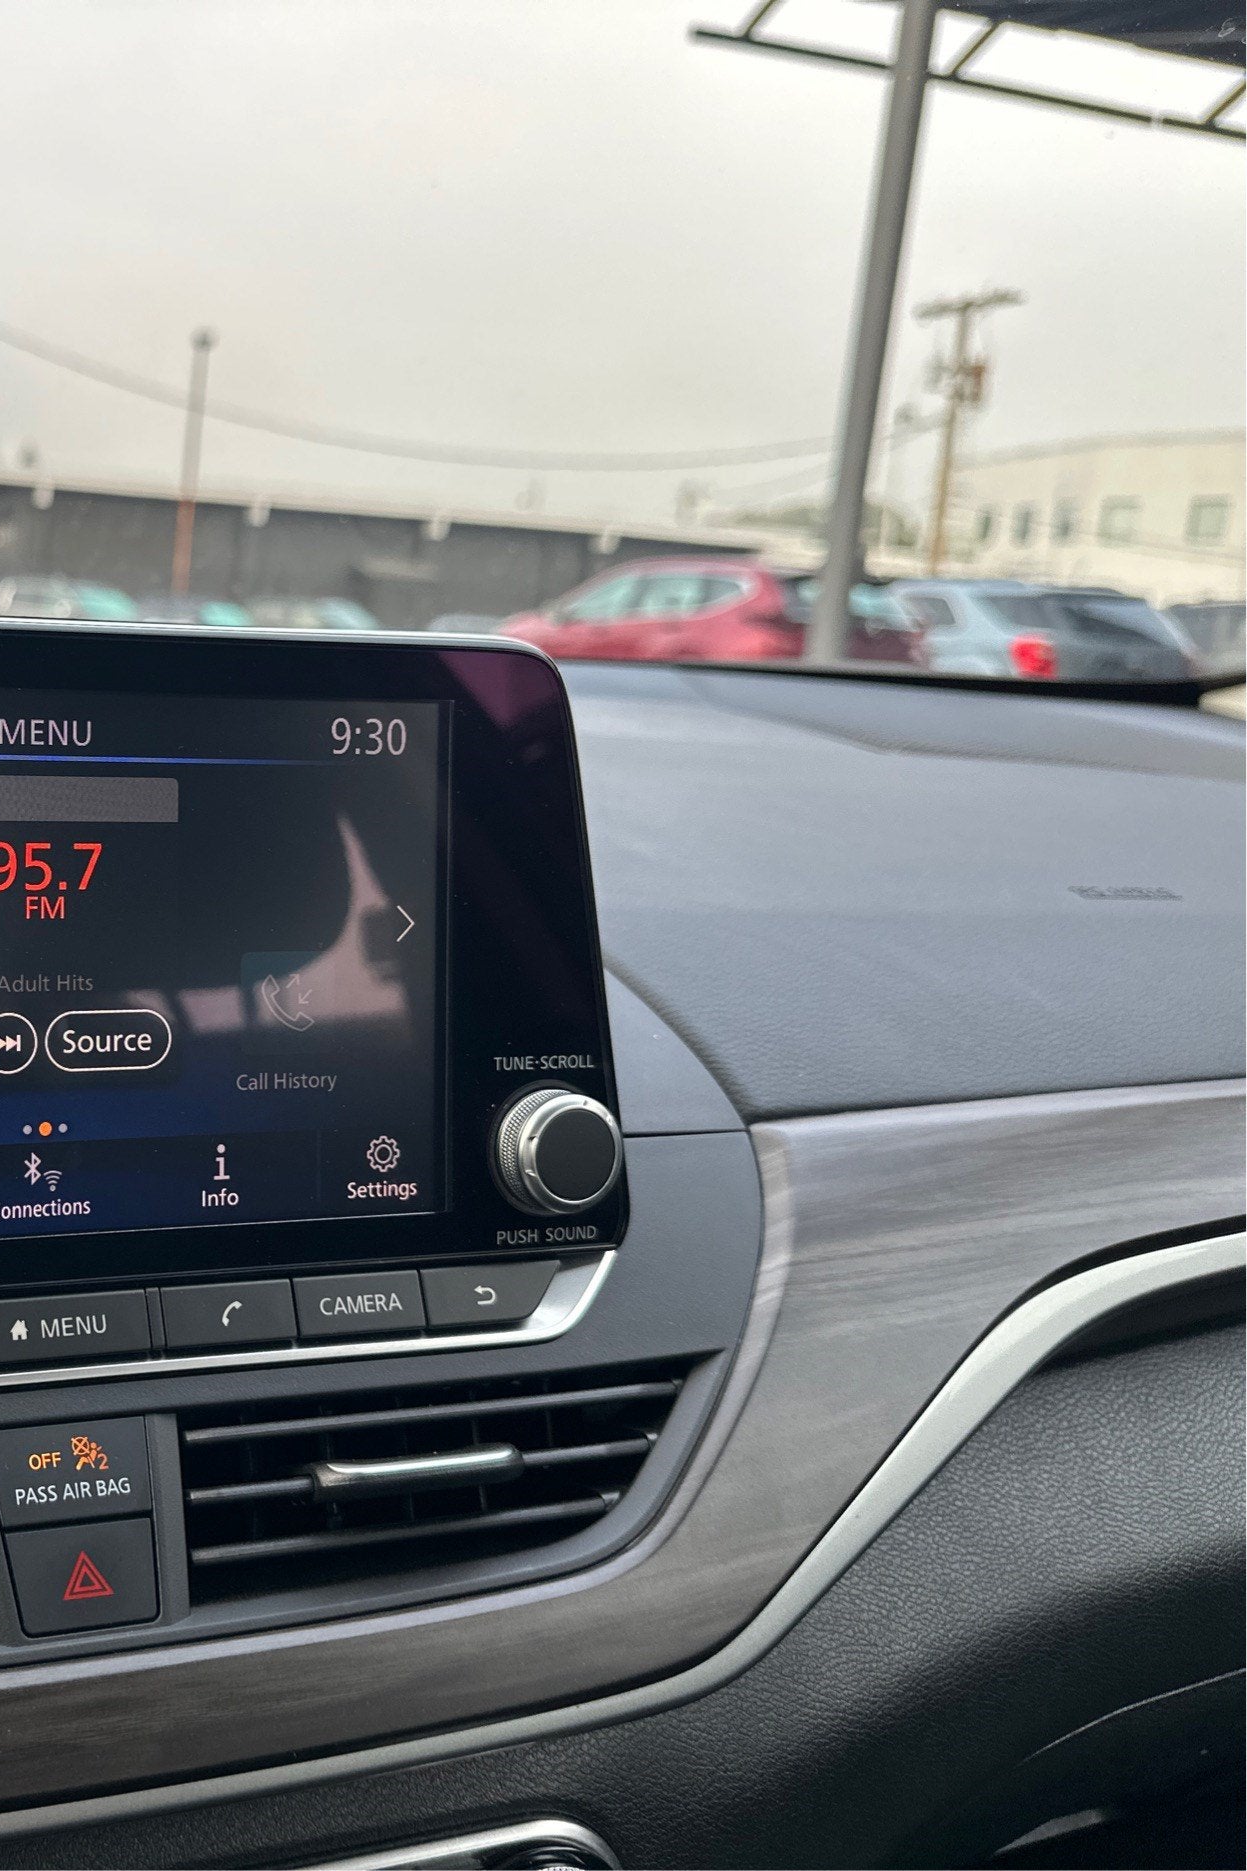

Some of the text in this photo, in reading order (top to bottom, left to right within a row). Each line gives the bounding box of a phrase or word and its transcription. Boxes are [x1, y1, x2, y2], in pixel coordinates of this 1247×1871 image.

[331, 717, 407, 756] 9:30
[25, 895, 65, 920] FM
[57, 974, 94, 992] Hits
[62, 1029, 152, 1054] Source
[236, 1072, 338, 1092] Call History
[201, 1187, 239, 1207] Info
[347, 1180, 418, 1201] Settings
[496, 1225, 598, 1245] PUSH SOUND
[319, 1292, 403, 1316] CAMERA
[40, 1314, 107, 1339] MENU
[28, 1451, 62, 1471] OFF
[15, 1477, 131, 1506] PASS AIR BAG
